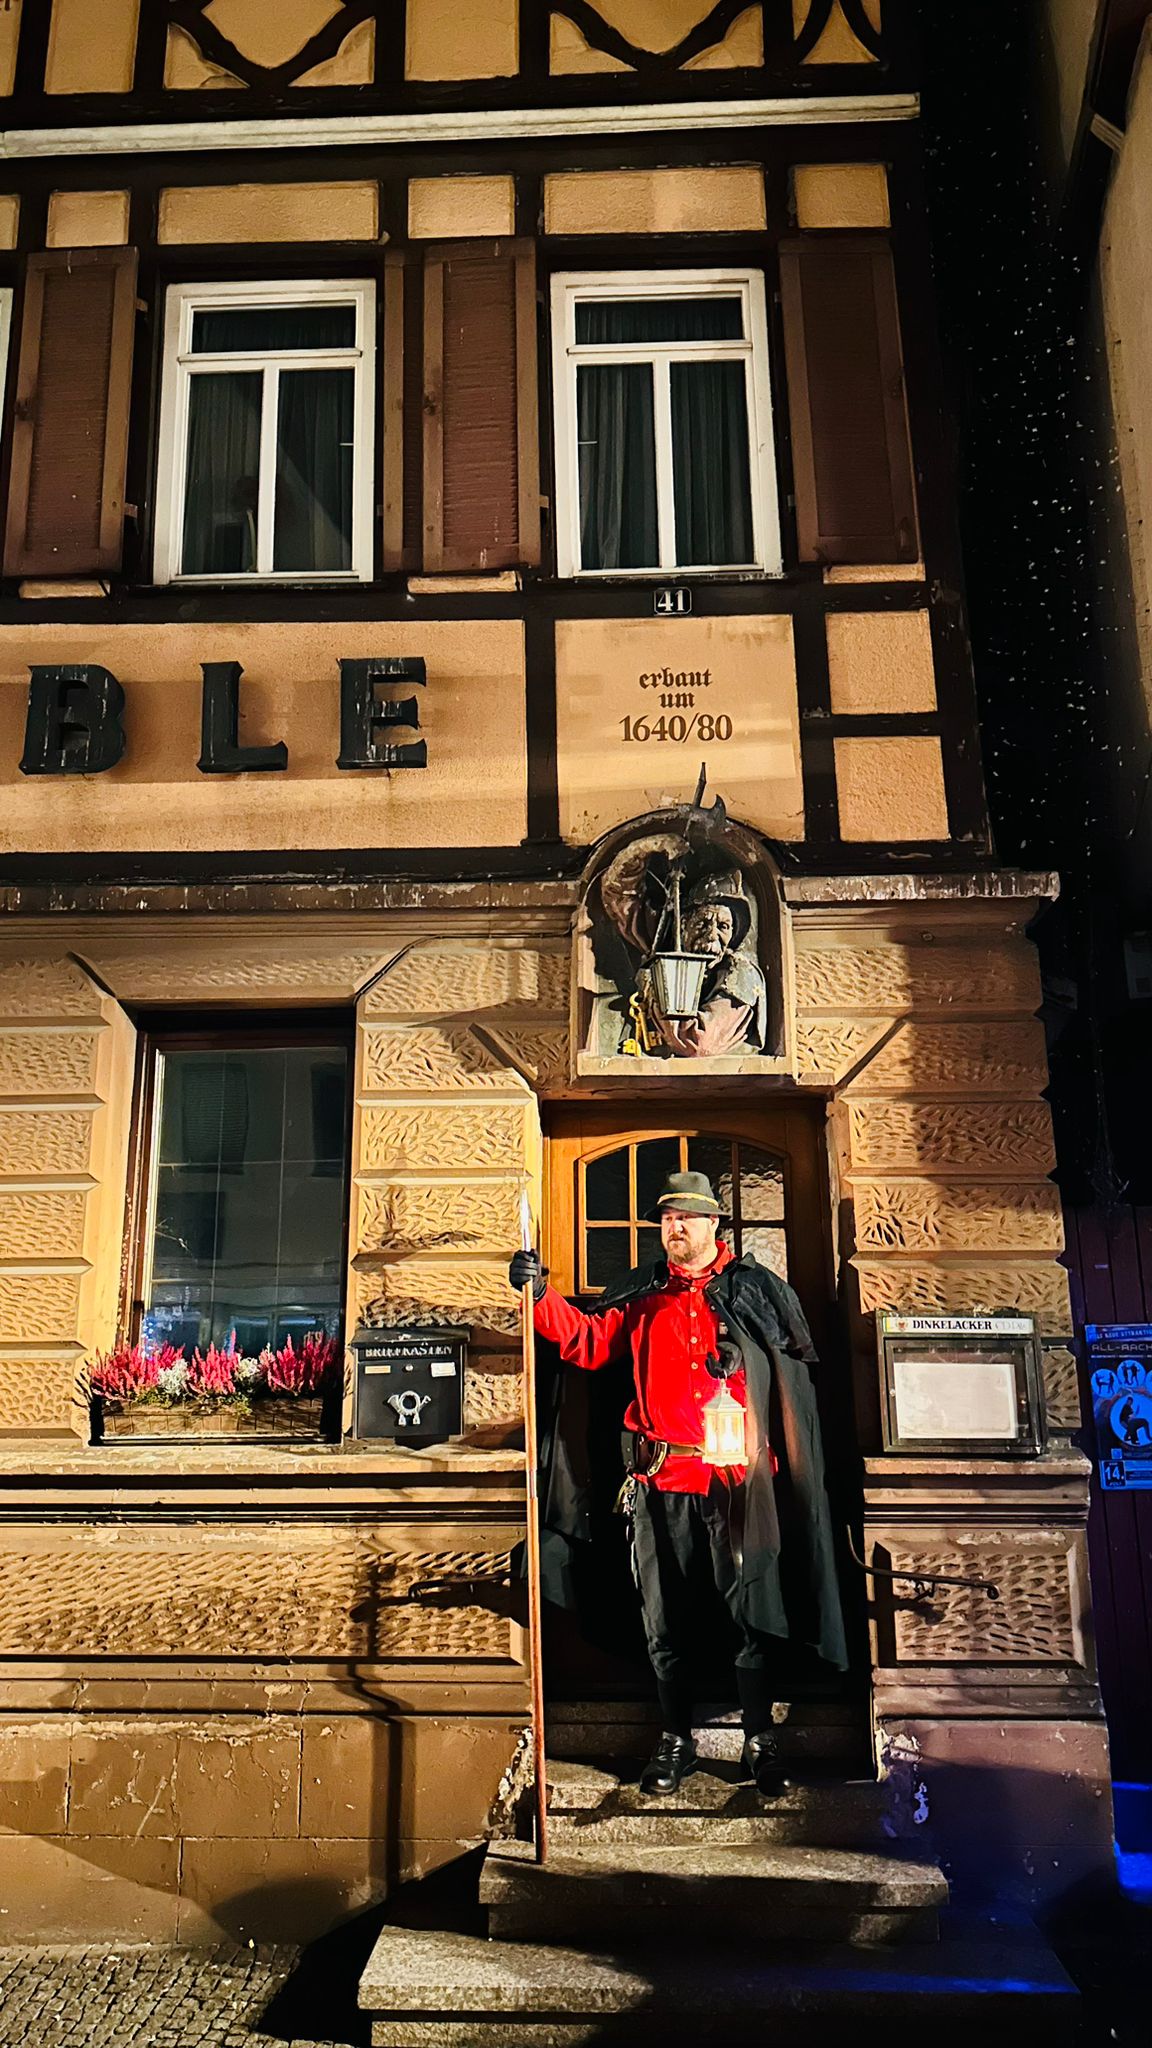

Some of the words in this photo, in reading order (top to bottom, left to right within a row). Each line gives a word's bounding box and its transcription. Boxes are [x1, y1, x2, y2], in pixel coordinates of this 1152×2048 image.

[657, 590, 685, 612] 41
[639, 667, 713, 689] erbaut
[658, 691, 695, 709] um
[18, 656, 428, 776] BLE
[618, 713, 733, 743] 1640/80
[913, 1319, 992, 1330] DINKELACKER
